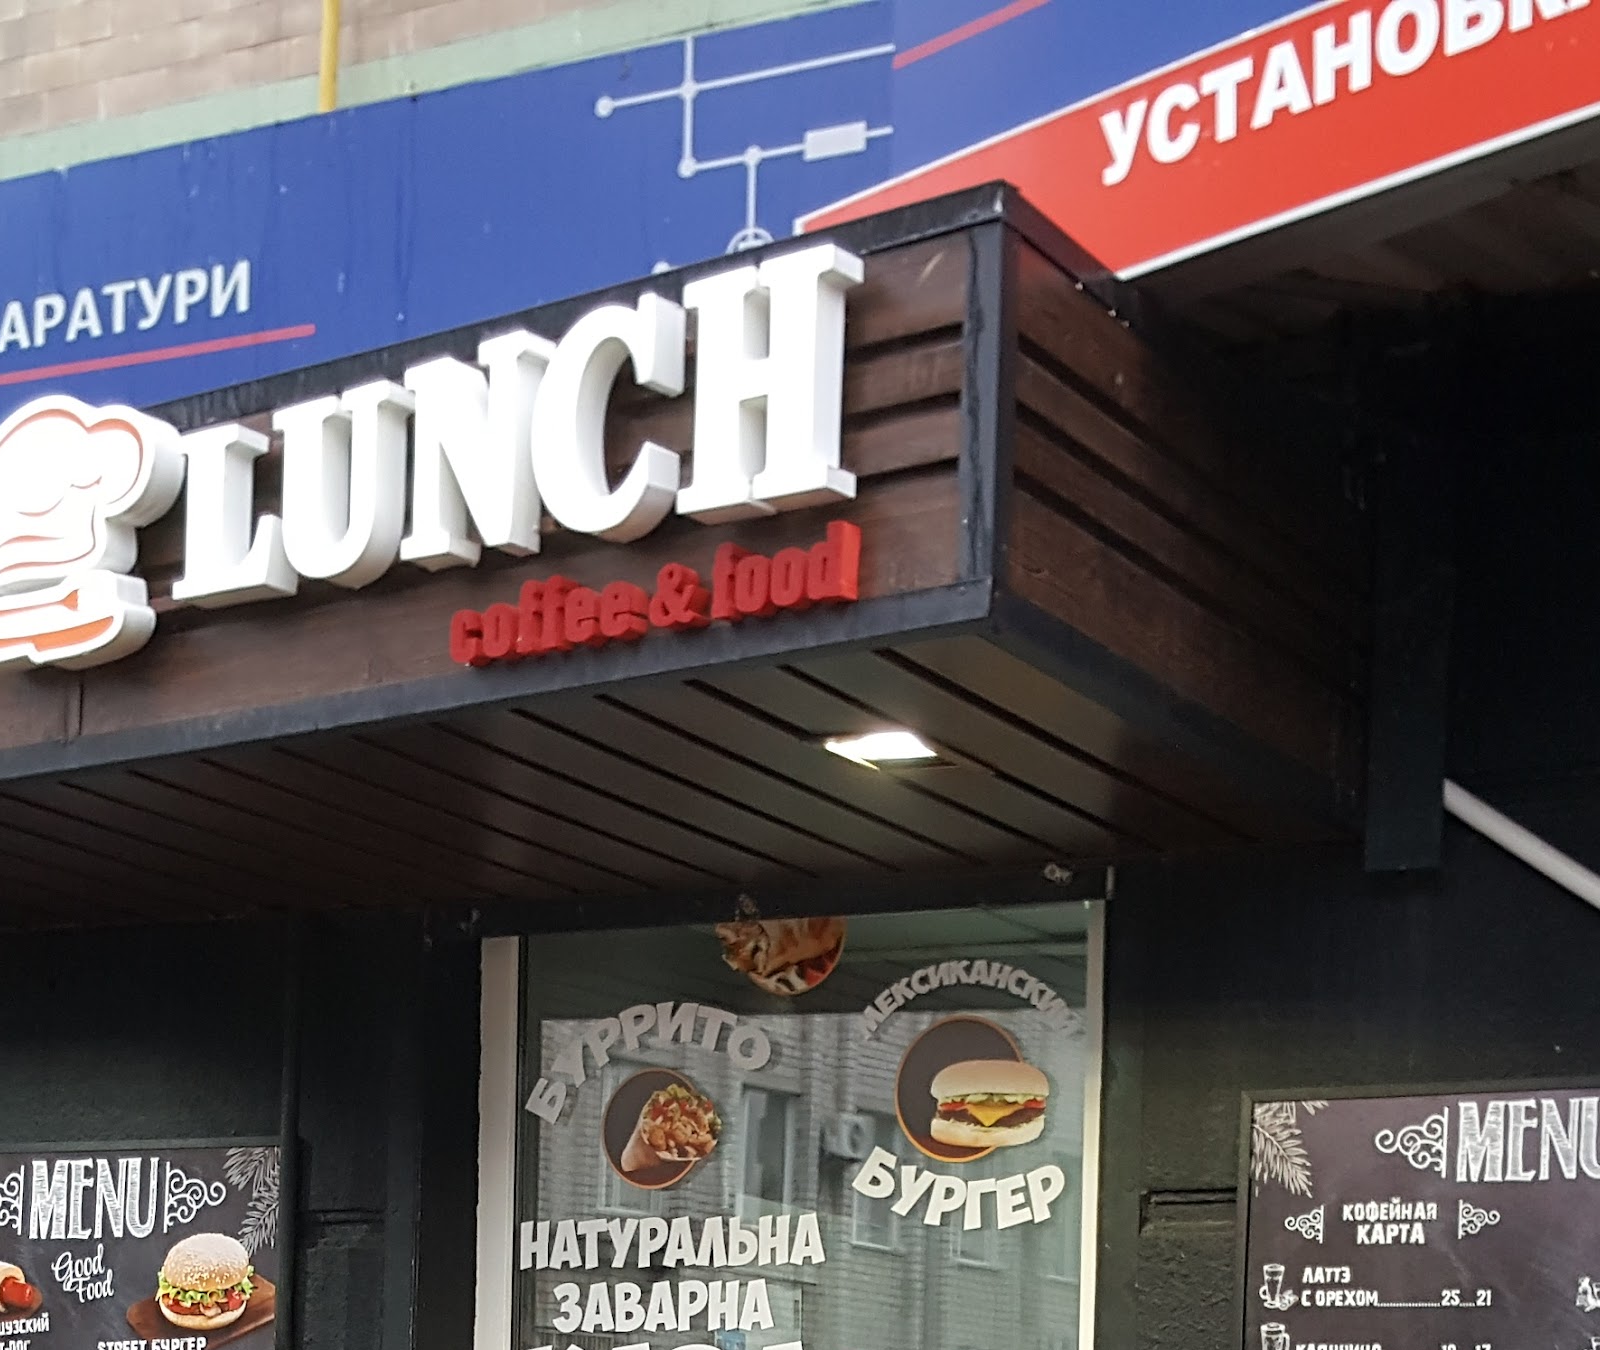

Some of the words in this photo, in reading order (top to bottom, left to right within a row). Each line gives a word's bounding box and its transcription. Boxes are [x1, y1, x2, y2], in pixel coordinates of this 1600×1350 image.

[1100, 0, 1592, 188] УСТАНОВ
[172, 243, 863, 604] LUNCH
[450, 574, 648, 667] coffee
[649, 562, 711, 628] &
[712, 520, 861, 620] food
[525, 1001, 770, 1125] БУРРИТО
[28, 1157, 159, 1240] MENU
[851, 1145, 1065, 1230] БУРГЕР
[1343, 1197, 1438, 1222] КОФЕЙНАЯ
[519, 1212, 826, 1270] НАТУРАЛЬНА
[1357, 1222, 1426, 1244] КАРТА
[51, 1244, 106, 1291] Good
[64, 1265, 114, 1303] Food
[1302, 1266, 1351, 1284] ЛАТТЭ
[551, 1277, 774, 1334] ЗАВАРНА
[1301, 1290, 1312, 1307] С
